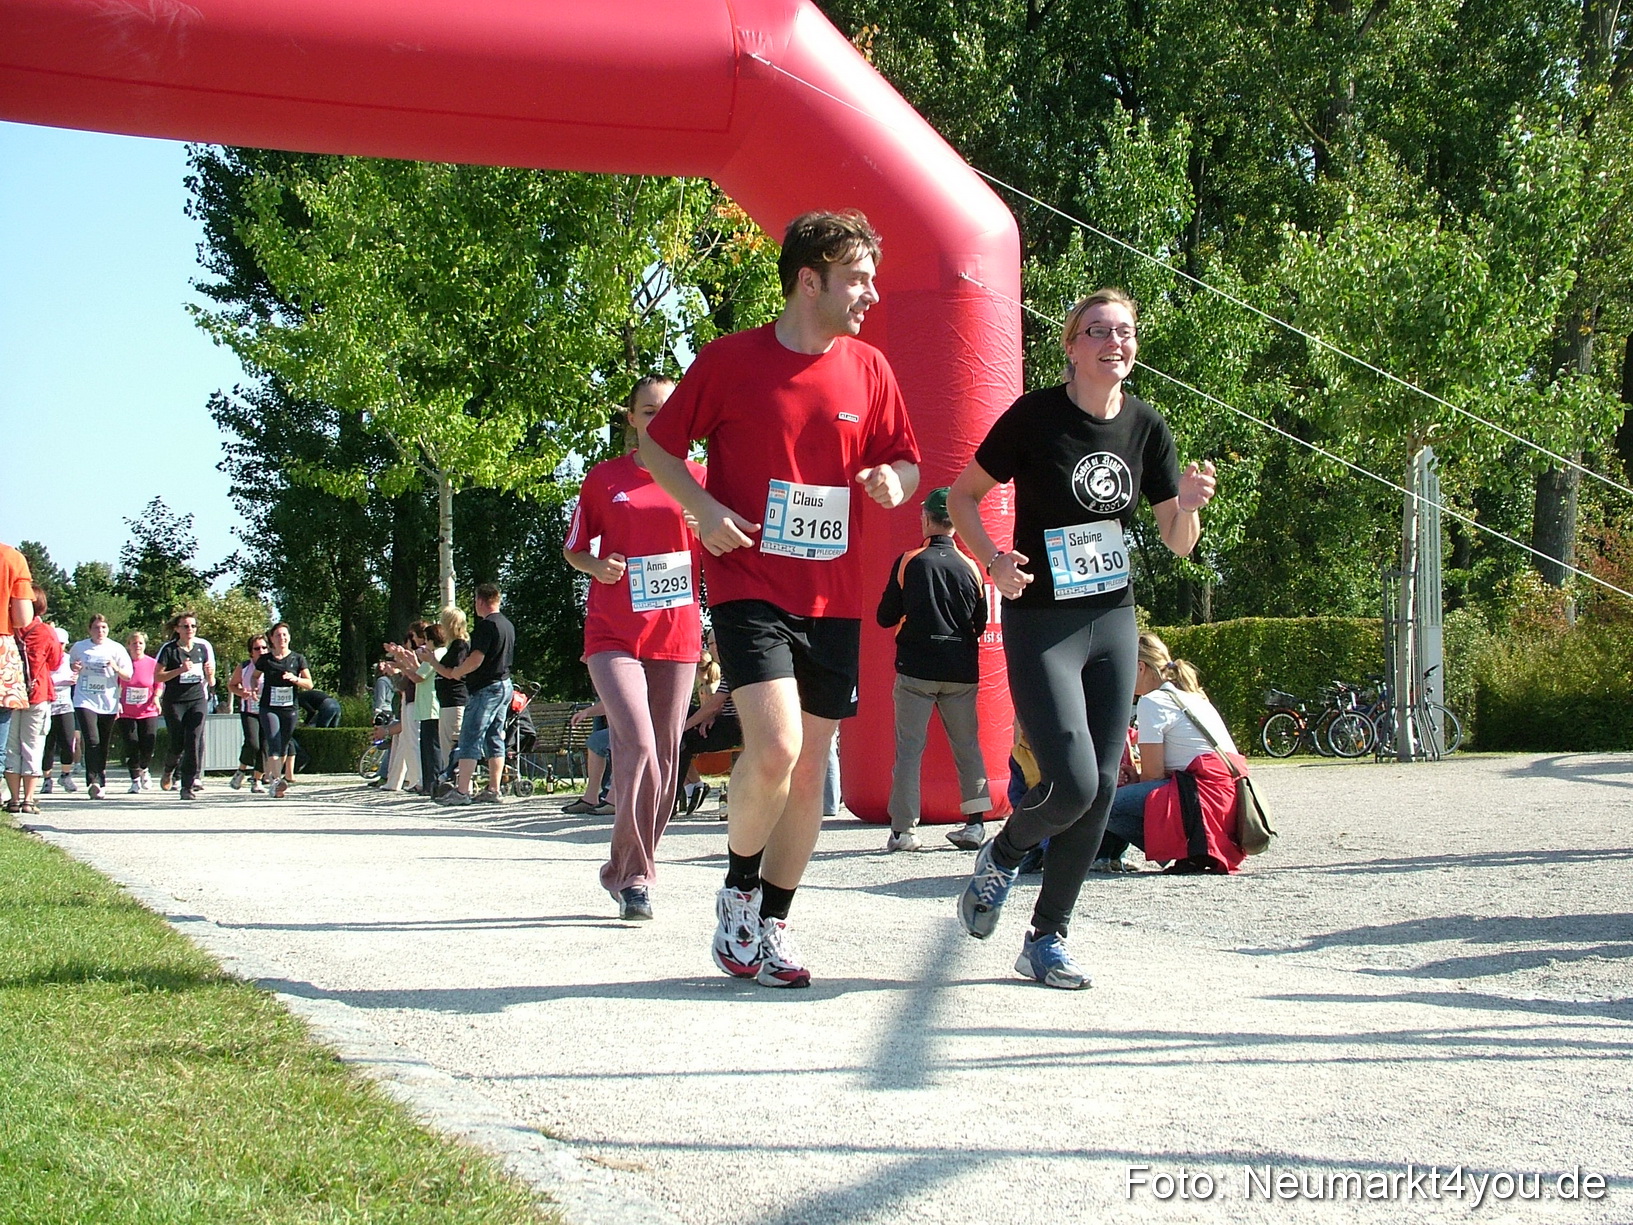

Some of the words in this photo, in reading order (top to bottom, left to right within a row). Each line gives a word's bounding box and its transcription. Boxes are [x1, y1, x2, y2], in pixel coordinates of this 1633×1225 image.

[793, 490, 824, 508] Claus
[1099, 500, 1120, 512] 2007
[790, 517, 843, 541] 3168
[1068, 531, 1103, 547] Sabine
[646, 561, 668, 572] Anna
[1074, 550, 1124, 576] 3150
[650, 575, 688, 595] 3293
